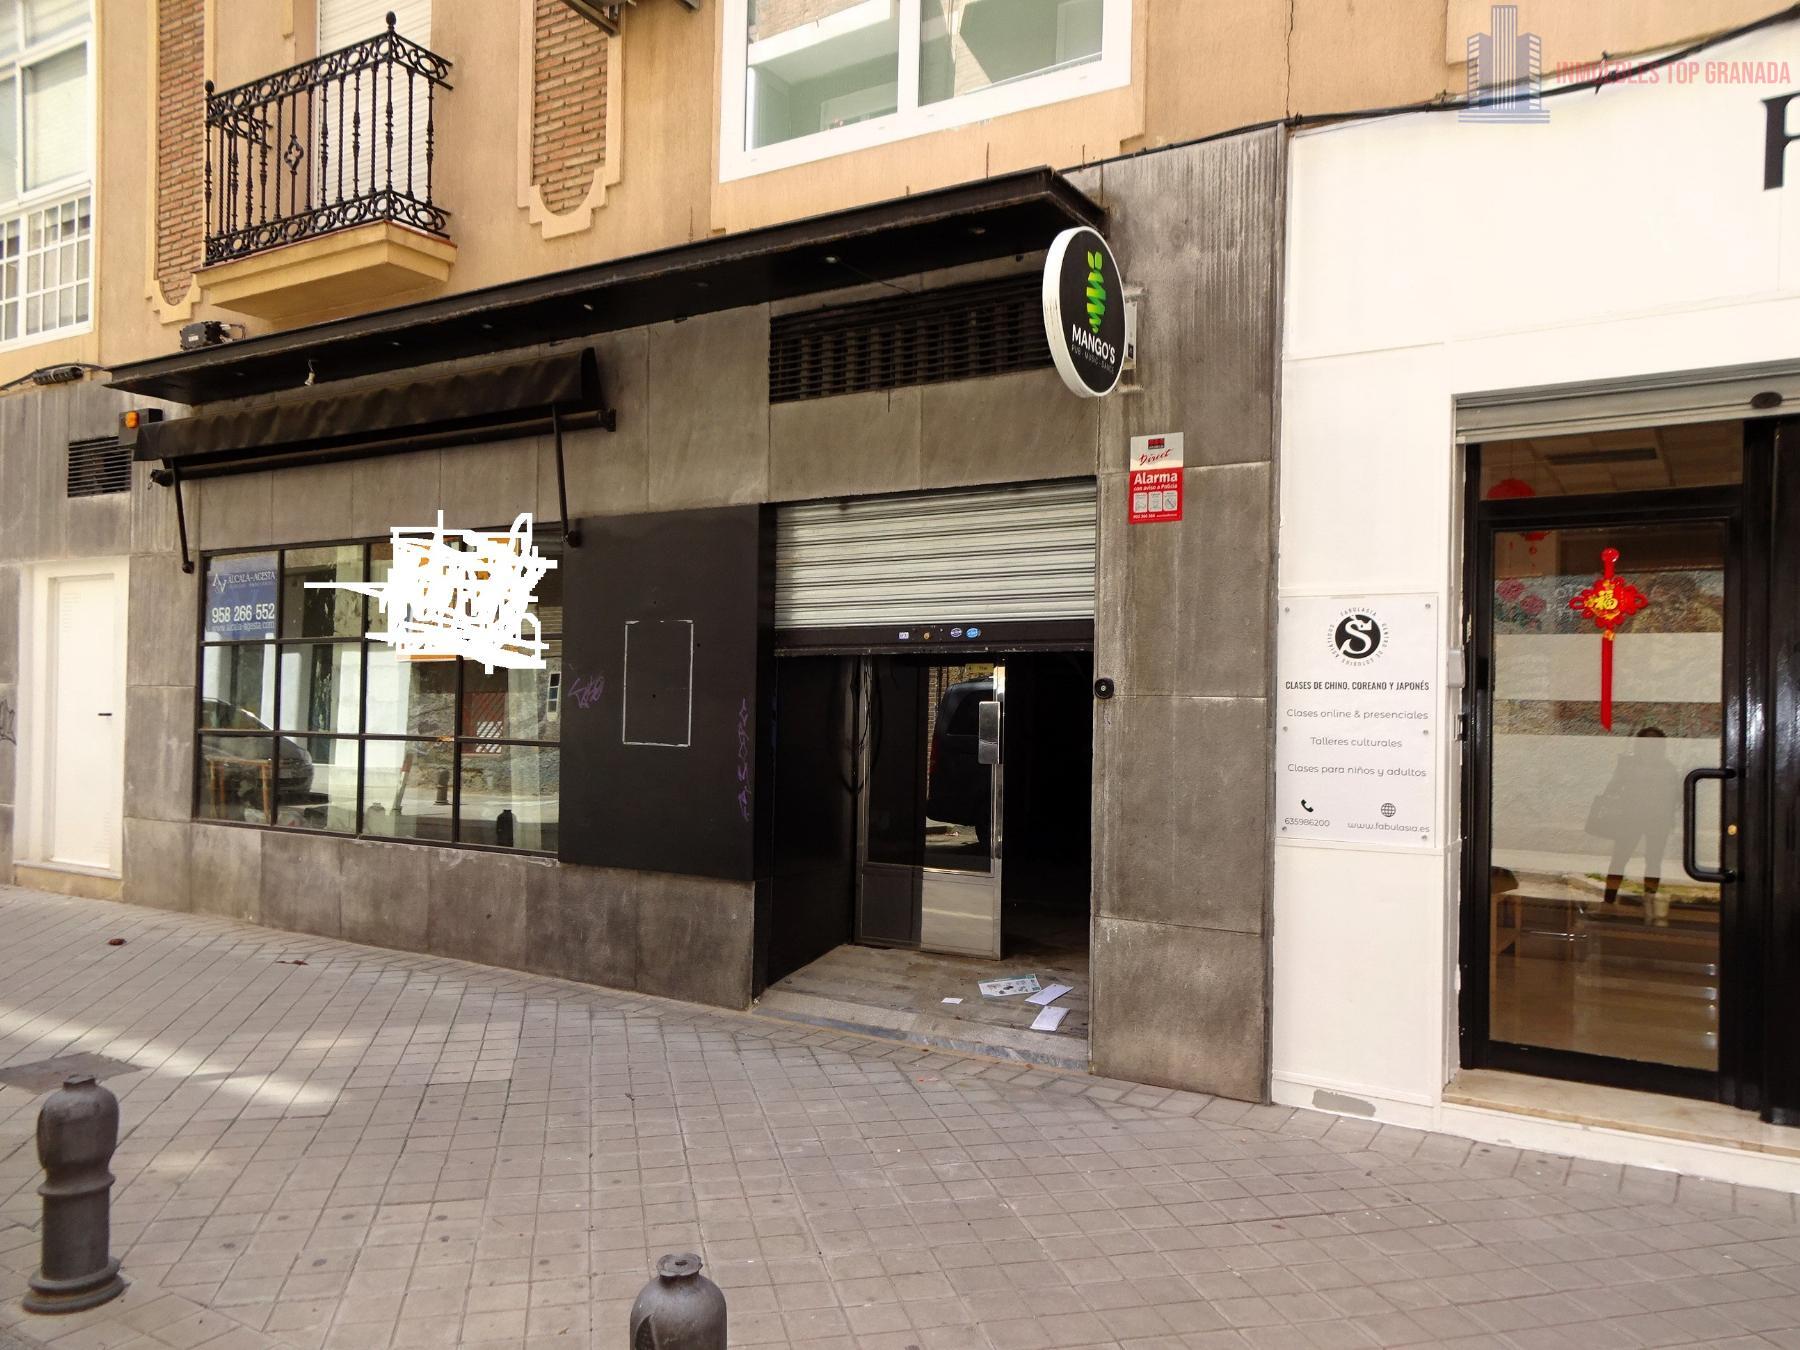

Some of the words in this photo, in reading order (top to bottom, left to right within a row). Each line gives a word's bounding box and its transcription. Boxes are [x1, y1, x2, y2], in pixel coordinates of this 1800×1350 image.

[1072, 323, 1116, 365] MANGO'S
[1133, 472, 1178, 485] Alarma
[212, 607, 231, 623] 958
[233, 605, 252, 621] 266
[255, 603, 275, 620] 552
[1285, 681, 1312, 690] CLASES
[1313, 681, 1322, 690] DE
[1352, 681, 1387, 691] COREANO
[1389, 682, 1394, 690] Y
[1396, 680, 1430, 691] JAPONÉS
[1286, 709, 1318, 718] Clases
[1320, 709, 1351, 718] online
[1353, 710, 1361, 718] &
[1363, 710, 1429, 721] presenciales
[1310, 737, 1349, 746] Talleres
[1350, 737, 1403, 748] culturales
[1287, 763, 1319, 773] Clases
[1321, 766, 1345, 776] para
[1347, 765, 1376, 775] niños
[1377, 768, 1384, 777] y
[1386, 767, 1427, 777] adultos
[1347, 822, 1431, 833] www.fabulasia.es
